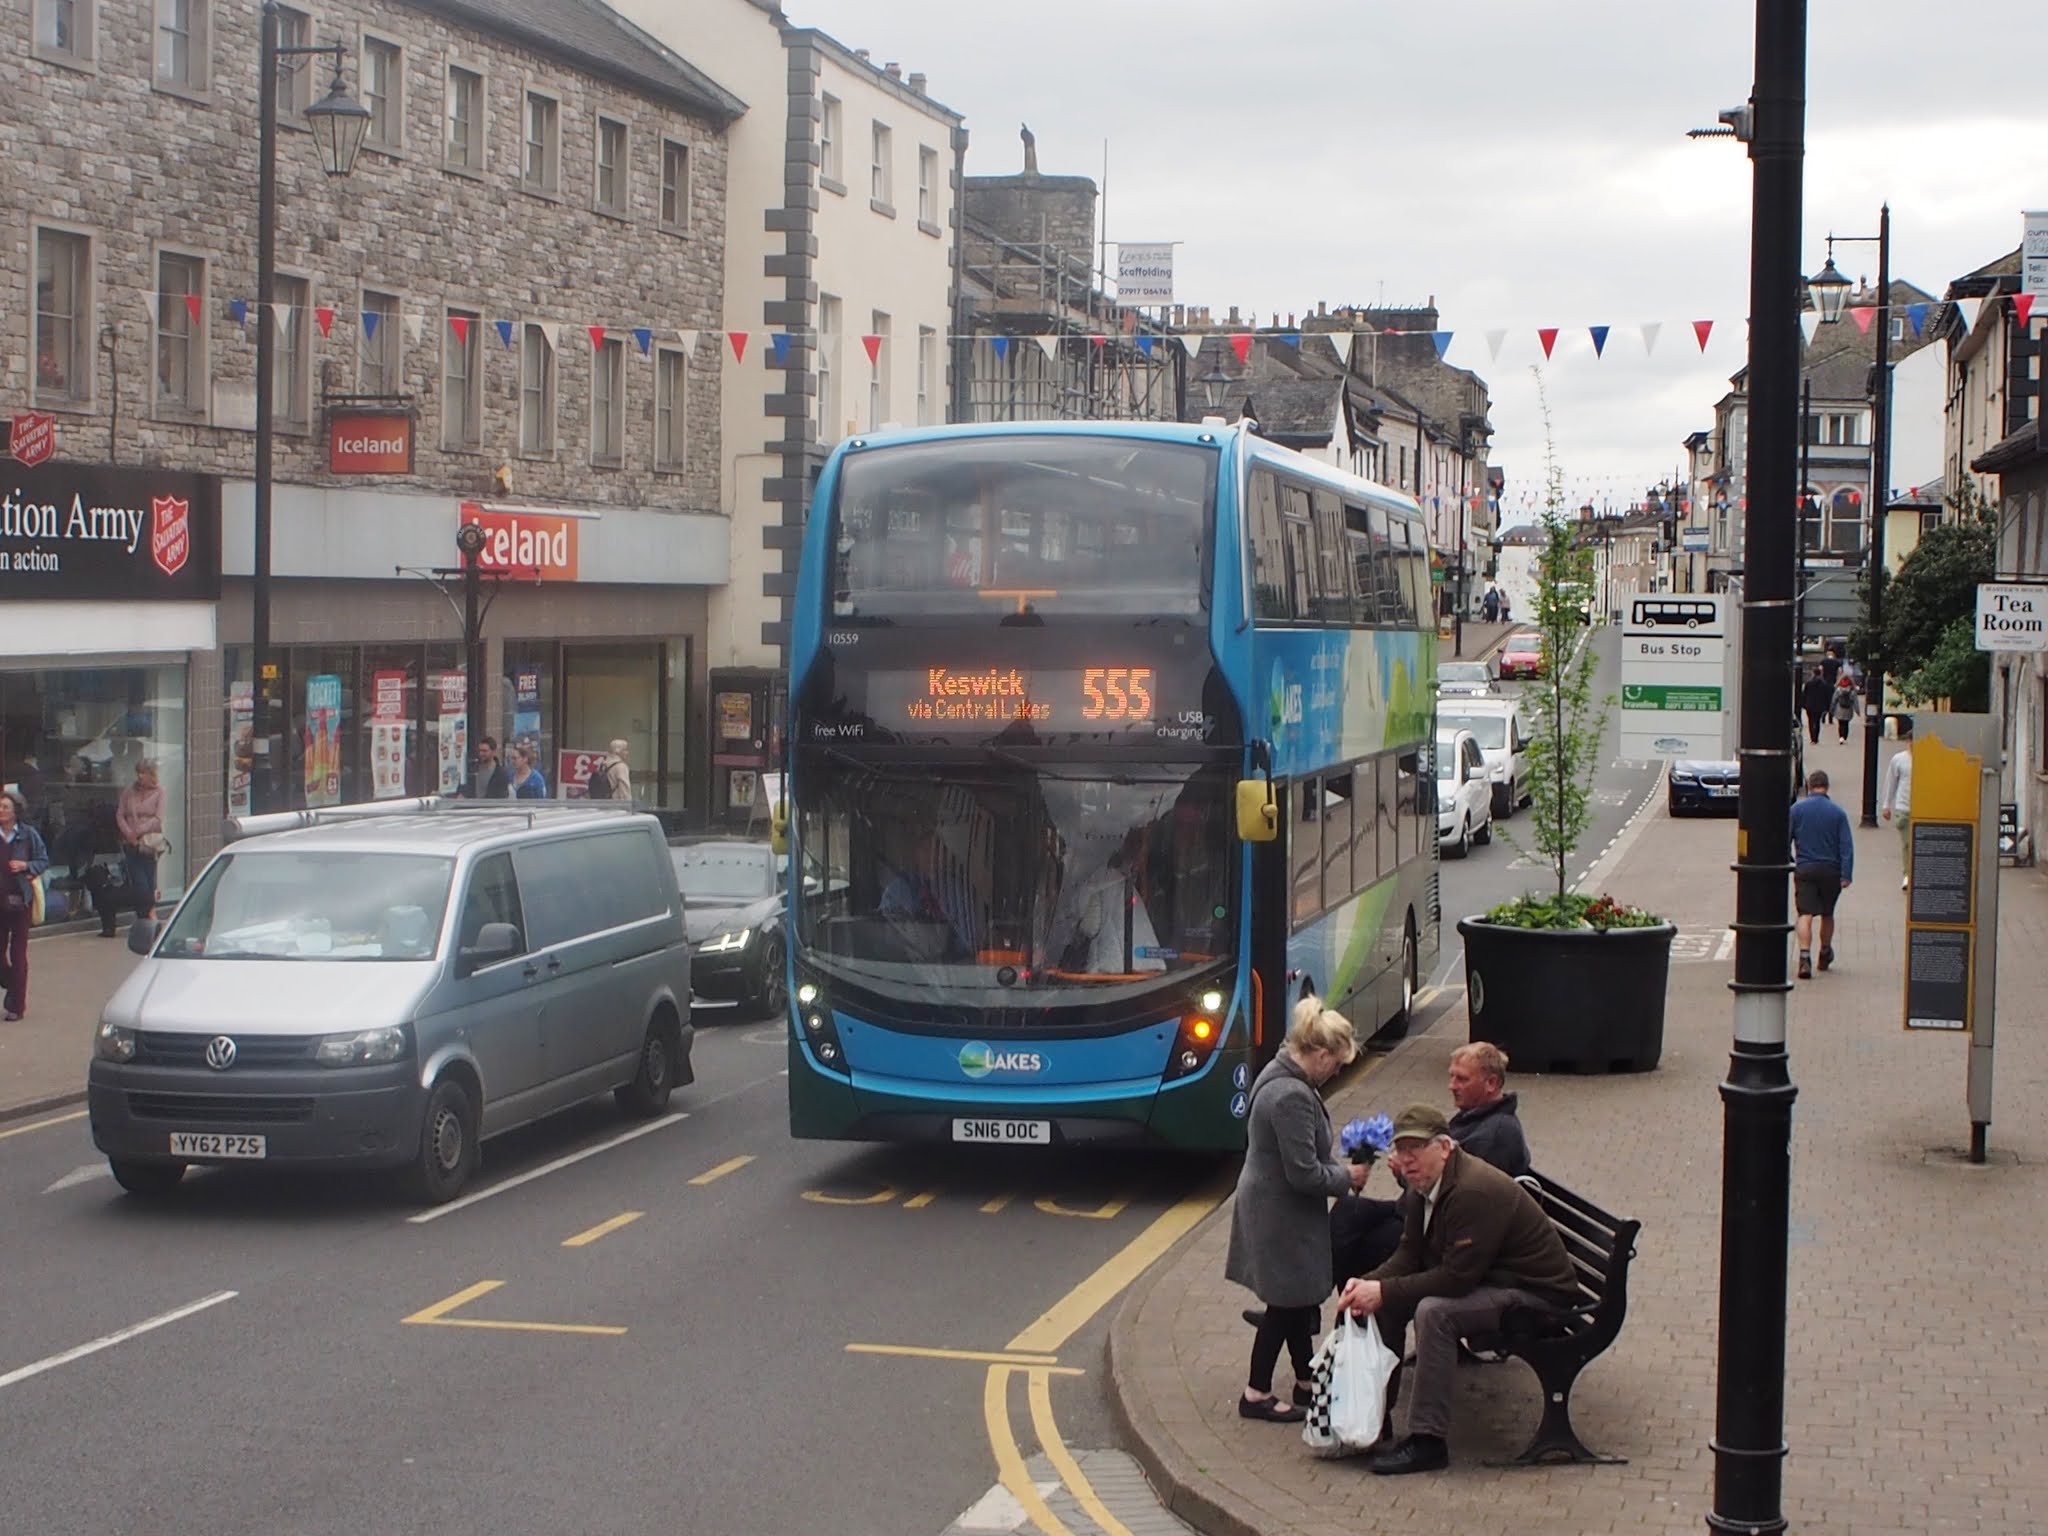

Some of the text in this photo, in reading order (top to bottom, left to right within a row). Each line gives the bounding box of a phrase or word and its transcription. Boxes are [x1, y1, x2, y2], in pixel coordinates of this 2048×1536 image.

[1119, 267, 1173, 279] Scaffolding
[18, 416, 35, 434] THE
[13, 420, 50, 453] SALVATION
[338, 437, 403, 454] Iceland
[25, 438, 48, 459] ARMY
[0, 488, 144, 553] tion Army
[160, 505, 174, 527] THE
[155, 512, 187, 552] SALVATION
[166, 534, 185, 565] ARMY
[472, 517, 568, 567] celand
[14, 546, 60, 571] action
[1994, 595, 2033, 612] Tea
[1983, 613, 2043, 631] Room
[829, 633, 859, 645] 10559
[1641, 643, 1701, 656] Bus Stop
[518, 674, 537, 691] FREE
[442, 690, 465, 702] VALUE
[929, 668, 1151, 720] Keswick 555
[908, 699, 1050, 720] via Central Lakes
[1178, 711, 1204, 723] USB
[814, 724, 864, 736] free WiFi
[1157, 727, 1204, 741] charging
[985, 1050, 1041, 1071] LAKES
[964, 1122, 1000, 1139] SN16
[178, 1134, 259, 1154] YY62 PZS
